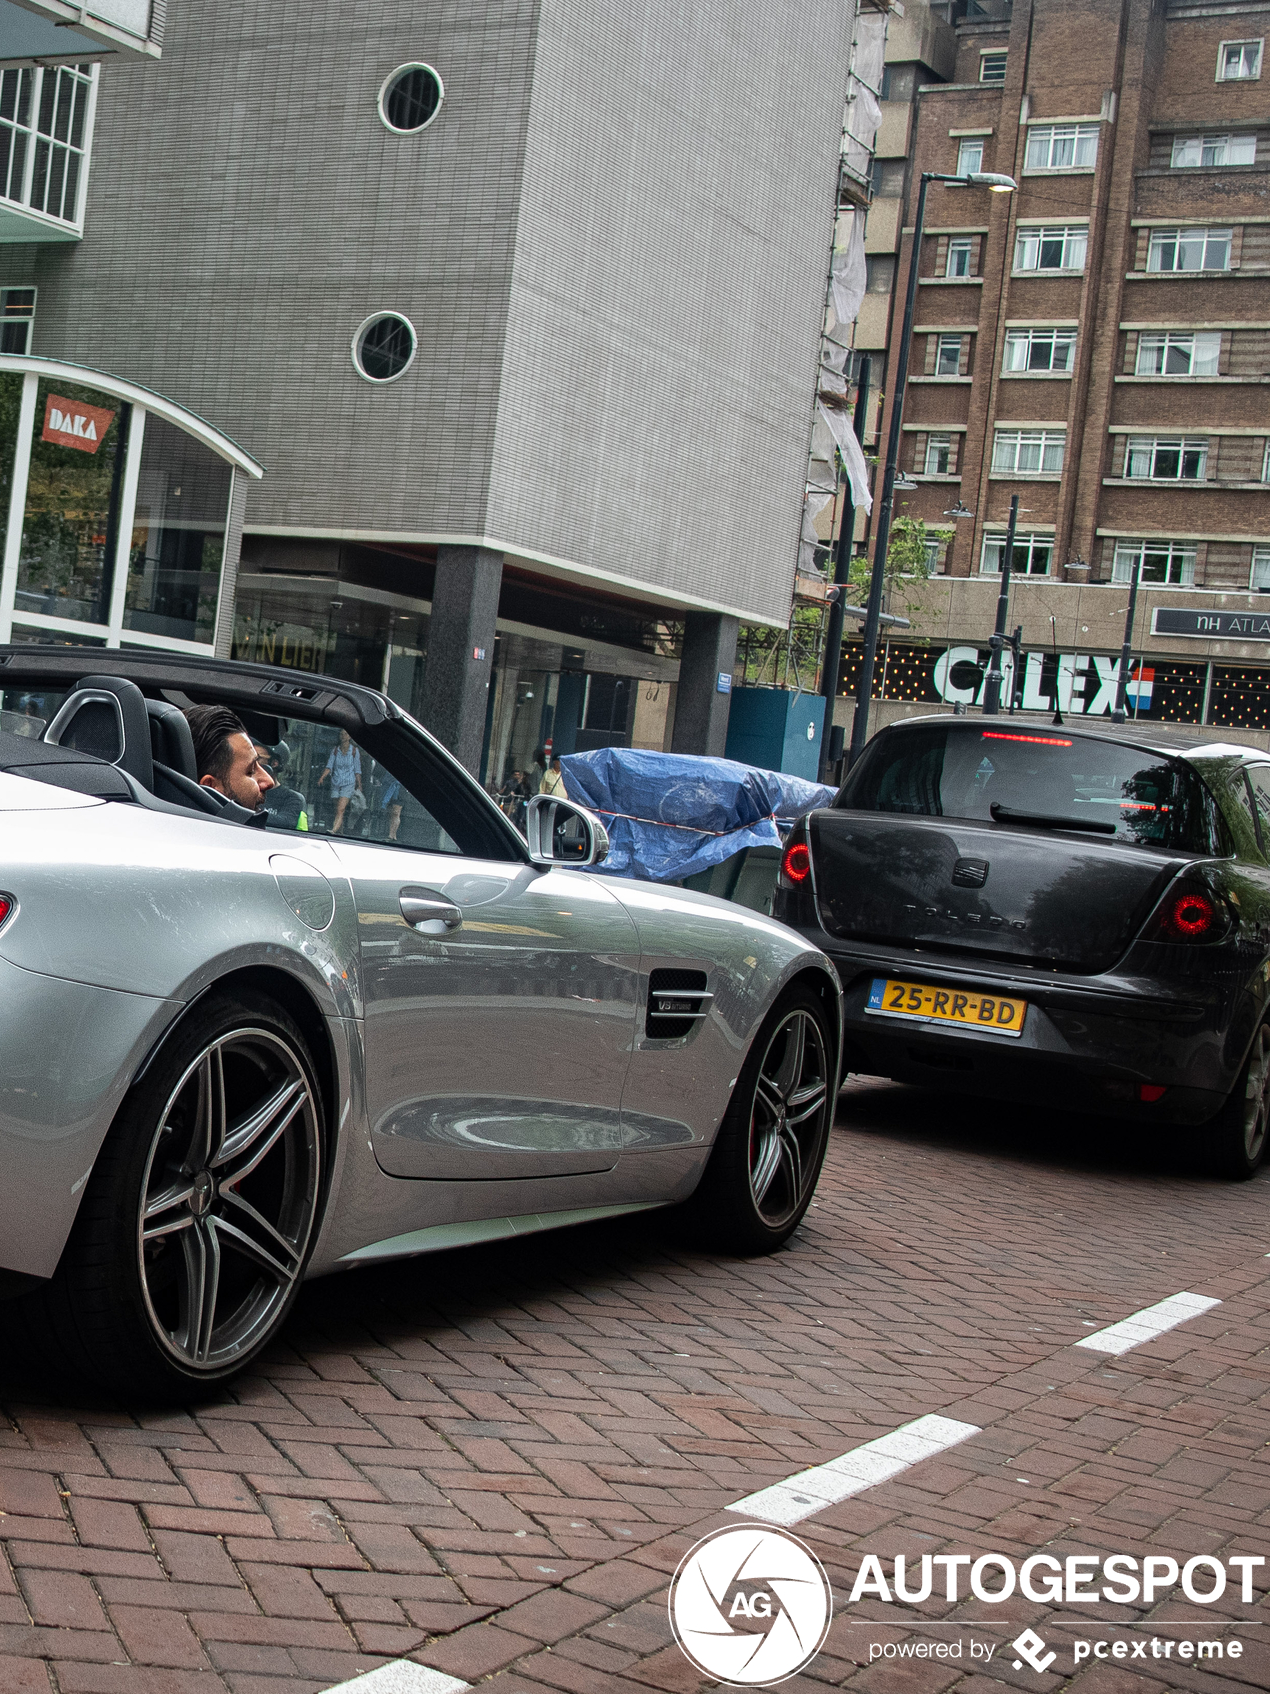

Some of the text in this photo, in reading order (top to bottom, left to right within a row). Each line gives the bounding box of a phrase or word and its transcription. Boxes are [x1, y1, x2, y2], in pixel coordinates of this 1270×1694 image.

[49, 408, 98, 441] DAKA
[903, 904, 1028, 930] TOLEDO
[658, 1001, 671, 1010] V8
[870, 996, 881, 1005] NL
[888, 985, 1015, 1024] 25-RR-BD
